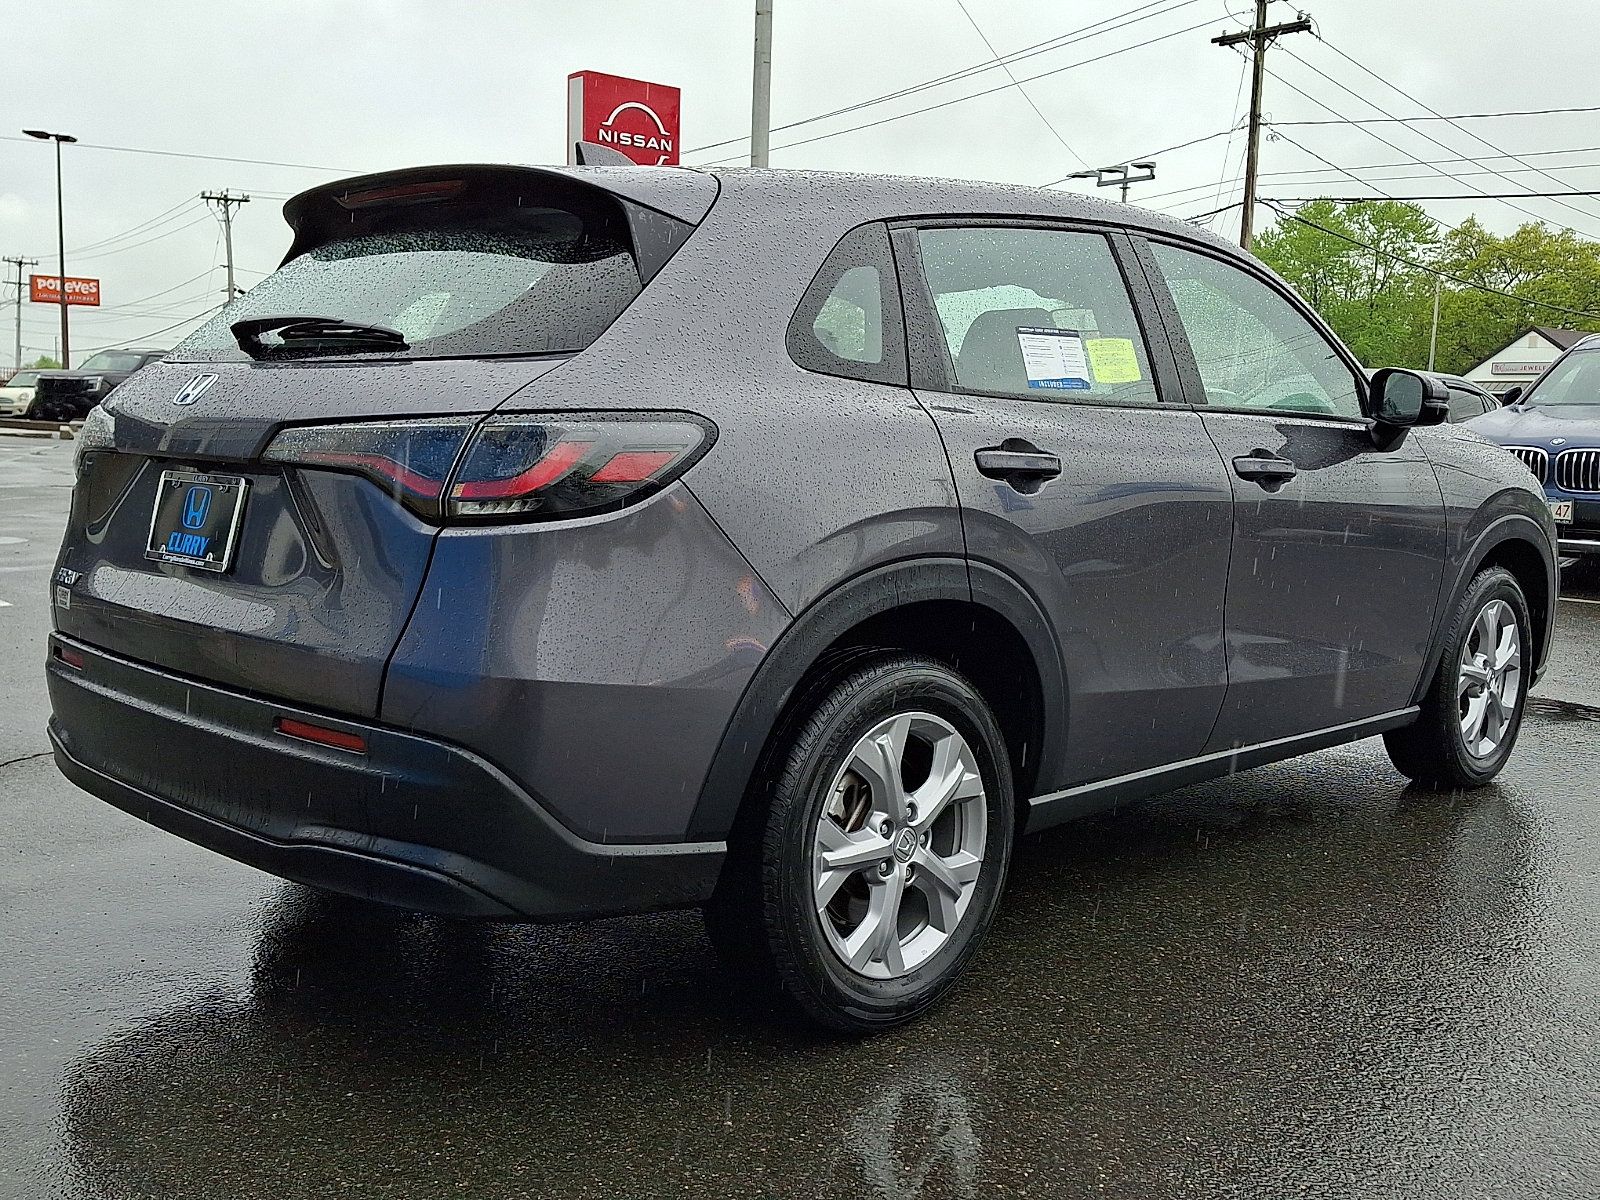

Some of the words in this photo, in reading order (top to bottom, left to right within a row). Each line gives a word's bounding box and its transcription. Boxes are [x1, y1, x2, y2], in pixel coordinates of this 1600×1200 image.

[598, 128, 672, 152] NISSAN
[1556, 505, 1570, 517] 47
[167, 532, 209, 556] CURRY
